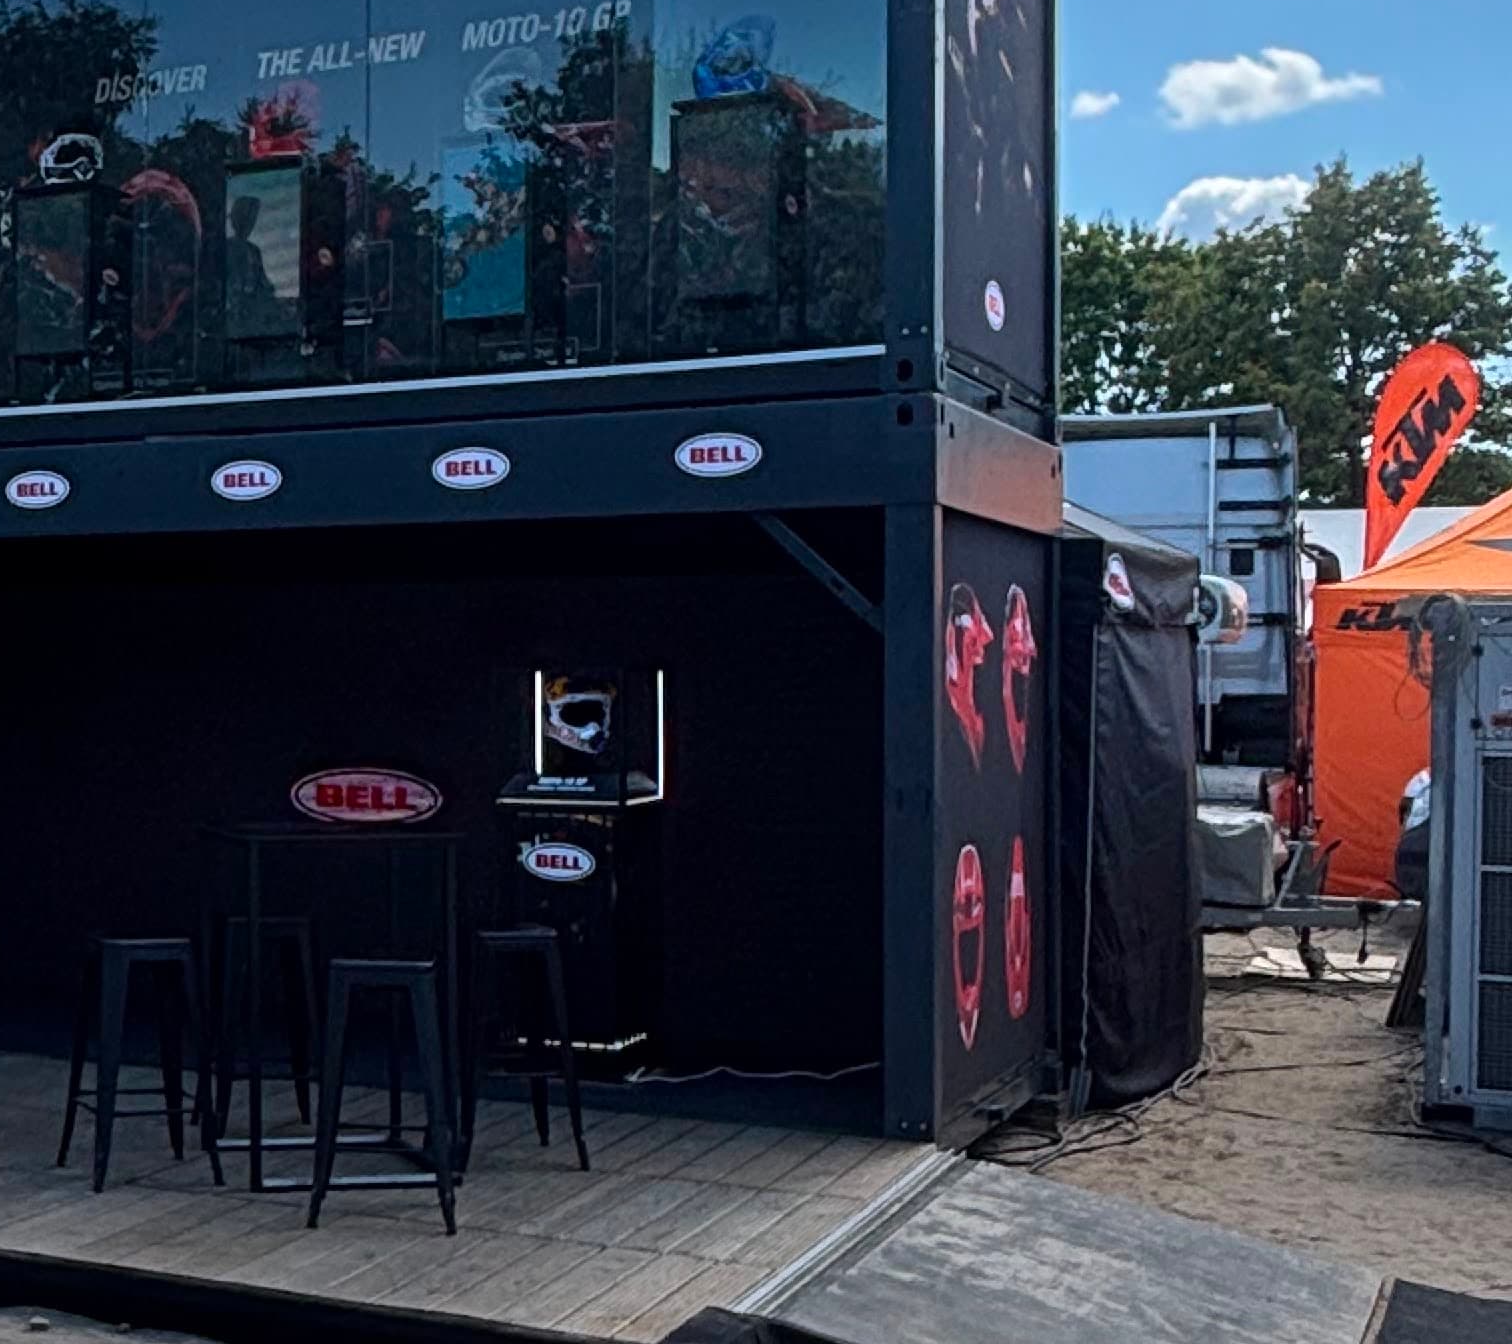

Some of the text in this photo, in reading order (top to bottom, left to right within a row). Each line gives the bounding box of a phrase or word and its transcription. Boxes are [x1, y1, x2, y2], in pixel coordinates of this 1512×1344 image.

[94, 64, 208, 104] DISCOVER
[257, 48, 304, 79] THE
[306, 30, 426, 74] ALL-NEW
[462, 6, 587, 52] MOTO-10
[1378, 373, 1467, 507] KTM
[690, 446, 748, 465] BELL
[445, 458, 497, 478] BELL
[223, 471, 271, 488] BELL
[16, 482, 59, 498] BELL
[315, 784, 417, 811] BELL
[535, 854, 584, 871] BELL
